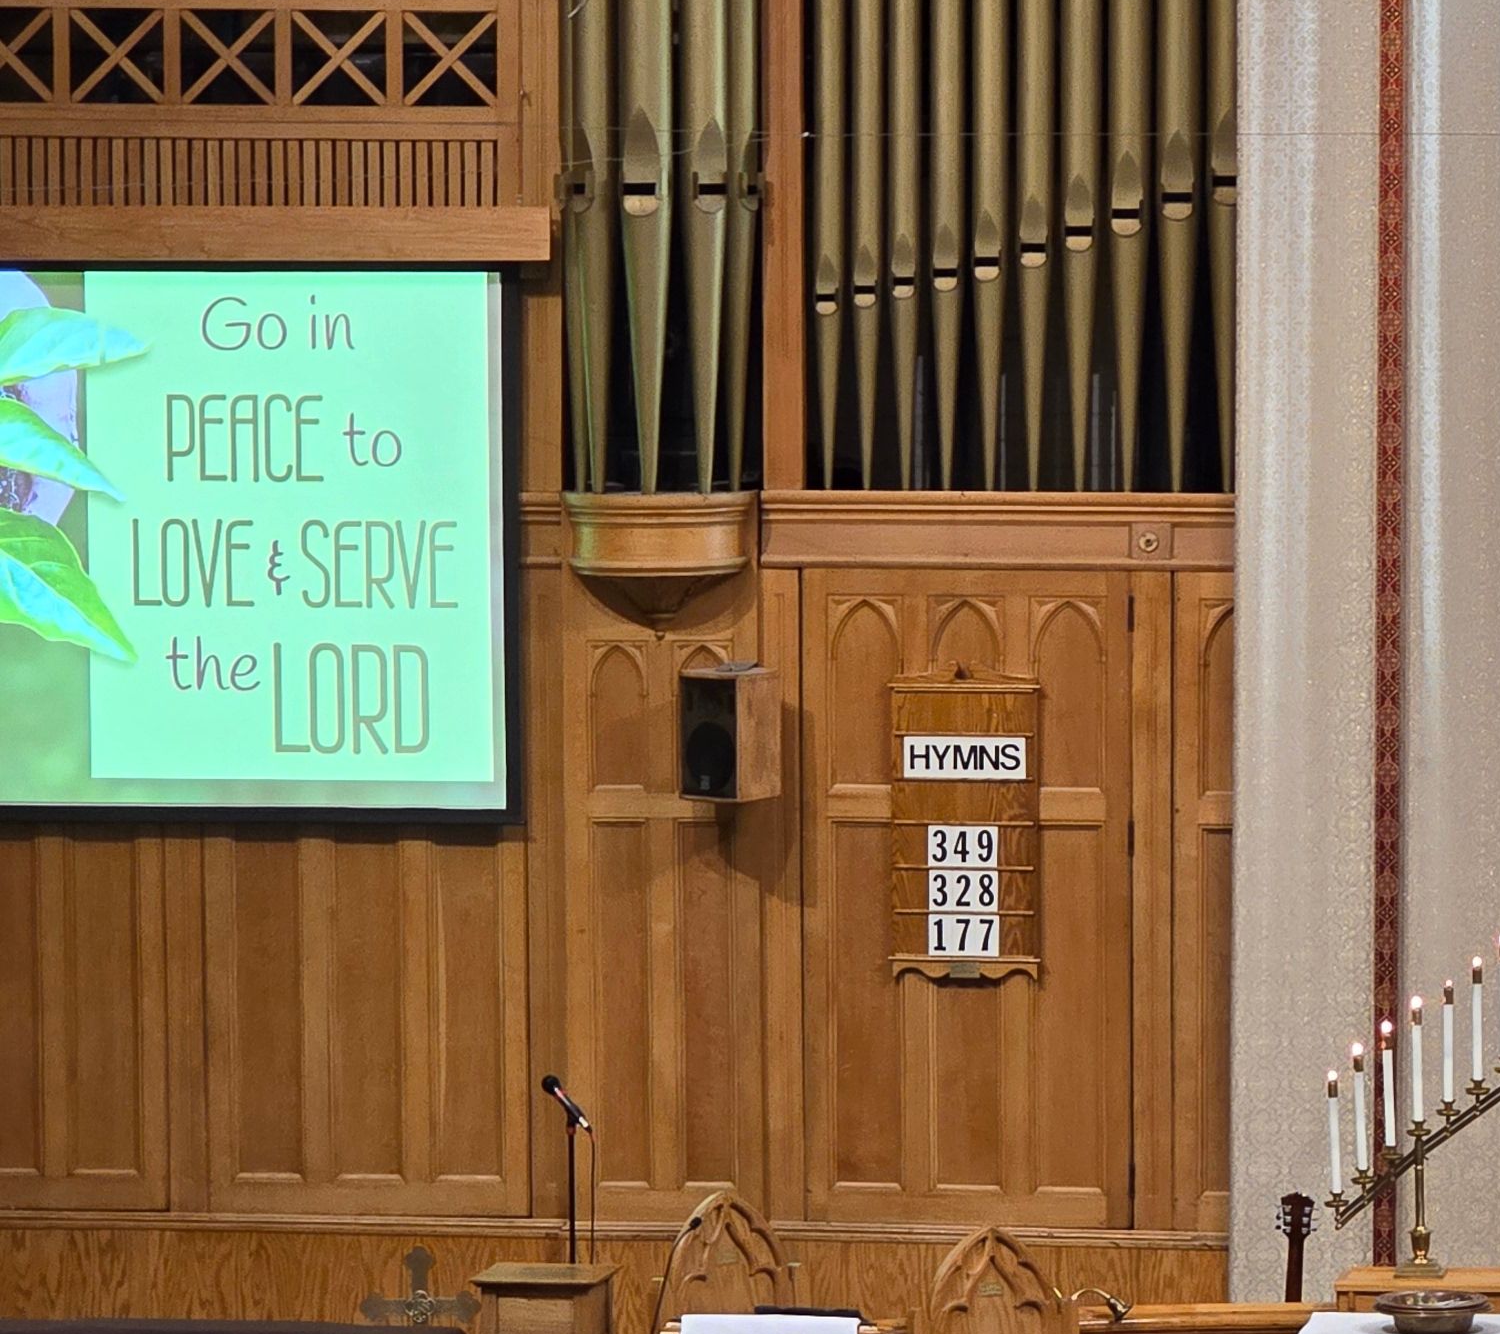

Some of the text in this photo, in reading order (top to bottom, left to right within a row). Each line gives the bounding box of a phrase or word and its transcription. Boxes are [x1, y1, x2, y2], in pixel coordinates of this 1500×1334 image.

[202, 295, 354, 350] Go in
[167, 394, 401, 482] PEACE to
[133, 519, 458, 609] LOVE & SERVE
[166, 636, 429, 754] the LORD
[910, 744, 1020, 770] HYMNS
[933, 830, 993, 862] 349
[933, 874, 994, 906] 328
[934, 919, 994, 951] 177
